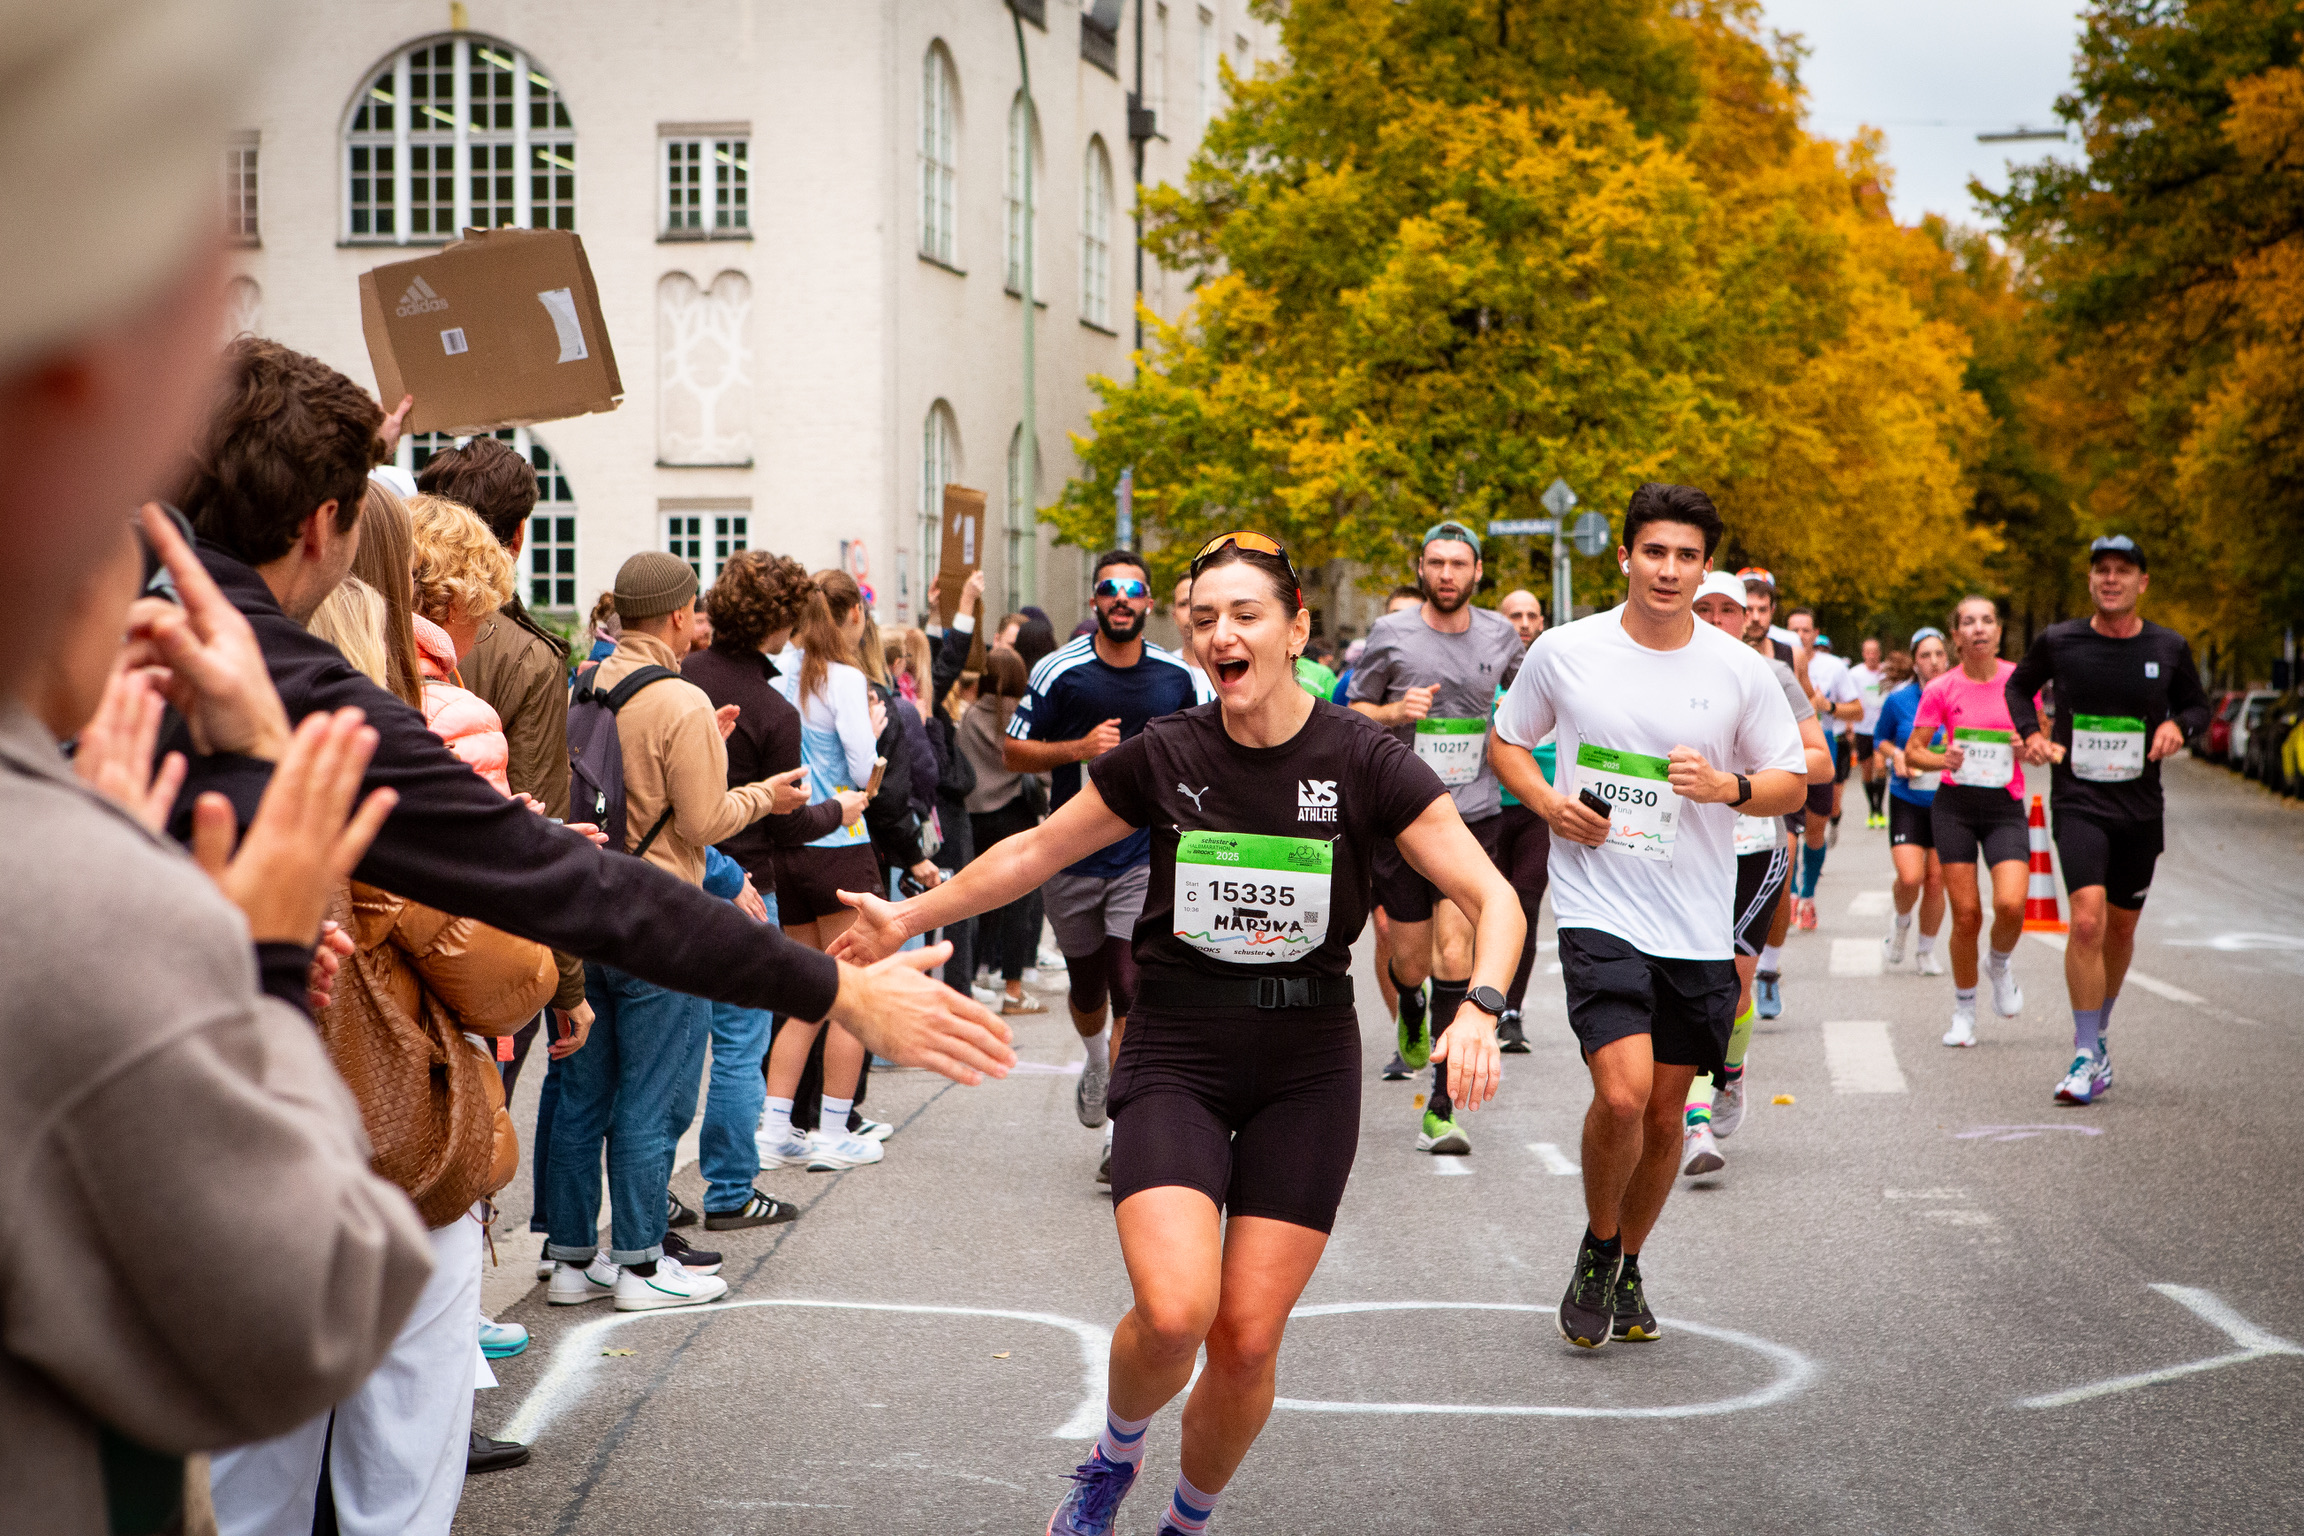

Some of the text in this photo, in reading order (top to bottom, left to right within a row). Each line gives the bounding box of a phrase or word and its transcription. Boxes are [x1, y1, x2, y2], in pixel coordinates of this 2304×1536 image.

[395, 297, 449, 317] adidas
[1433, 741, 1469, 753] 10217
[2088, 737, 2127, 750] 21327
[1603, 760, 1620, 770] 2025
[1595, 782, 1658, 807] 10530
[1297, 807, 1338, 822] ATHLETE
[1613, 804, 1633, 815] Tuna
[1201, 837, 1229, 846] schuster
[1216, 851, 1240, 861] 2025
[1186, 891, 1197, 902] C
[1208, 880, 1295, 907] 15335
[1213, 914, 1304, 933] MARYNA
